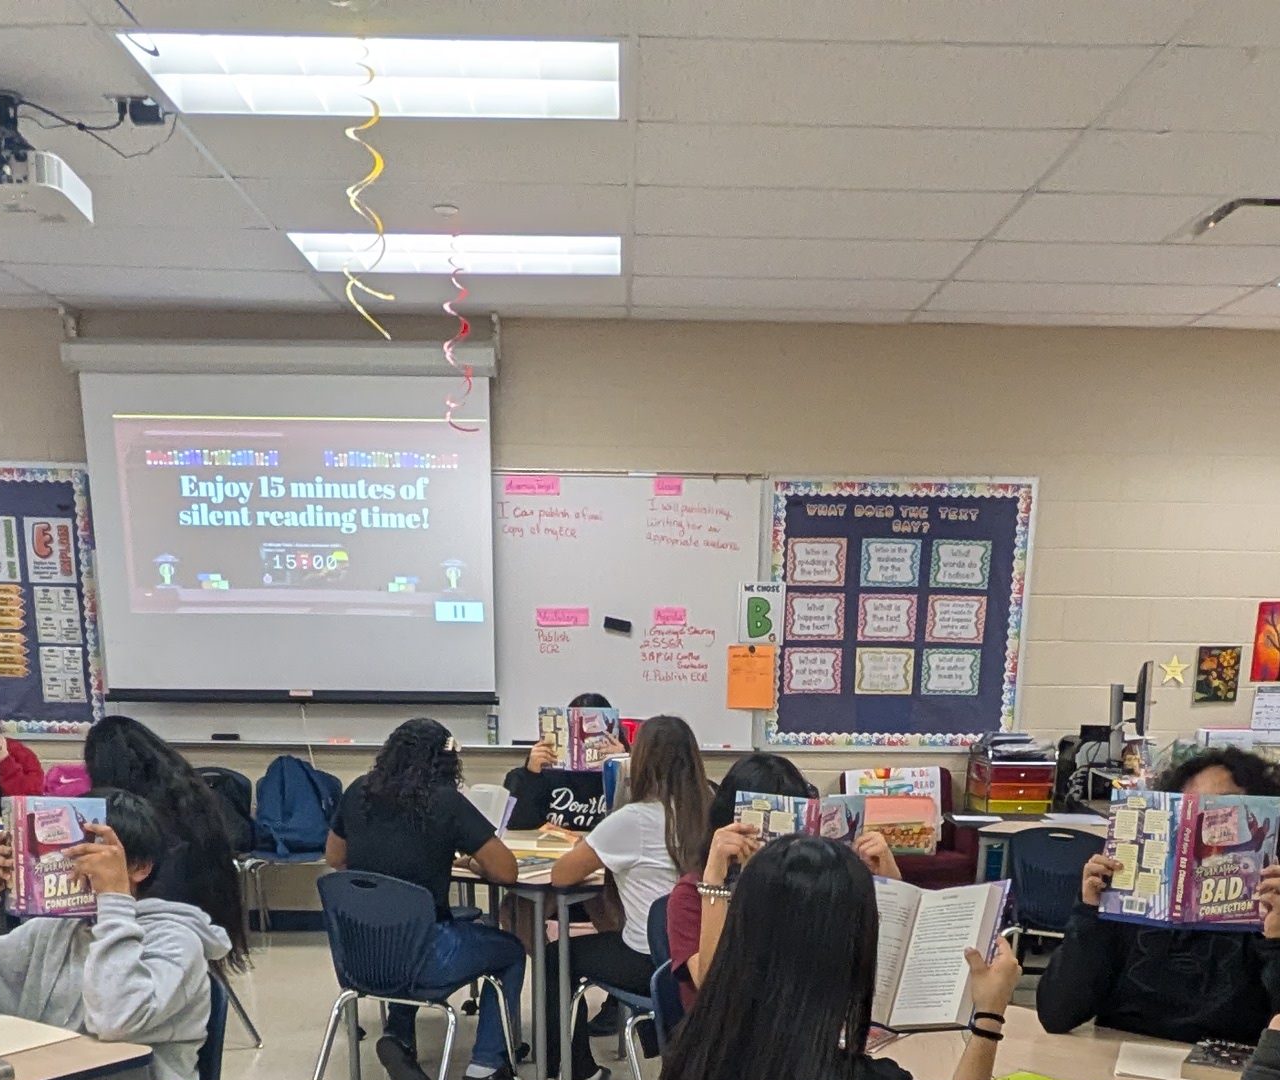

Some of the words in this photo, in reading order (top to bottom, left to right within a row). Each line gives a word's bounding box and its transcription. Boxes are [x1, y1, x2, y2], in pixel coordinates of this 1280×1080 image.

[180, 475, 253, 504] Enjoy
[258, 476, 286, 498] 15
[290, 476, 395, 500] minutes
[399, 476, 430, 501] of
[179, 503, 252, 527] silent
[255, 504, 357, 534] reading
[360, 506, 430, 530] time!
[806, 503, 847, 517] WHAT
[854, 504, 895, 518] DOES
[899, 505, 929, 519] THE
[938, 507, 980, 521] TEXT
[891, 519, 931, 533] SAY?
[32, 522, 54, 559] E
[273, 554, 337, 570] 15:00
[744, 584, 754, 592] WE
[756, 584, 781, 593] CHOSE
[747, 596, 773, 638] B
[911, 768, 930, 778] KIDS
[914, 780, 935, 789] READ
[549, 787, 597, 815] Don't
[1200, 876, 1243, 905] BAD
[45, 894, 96, 910] CONNECTION
[1200, 900, 1254, 917] CONNECTION
